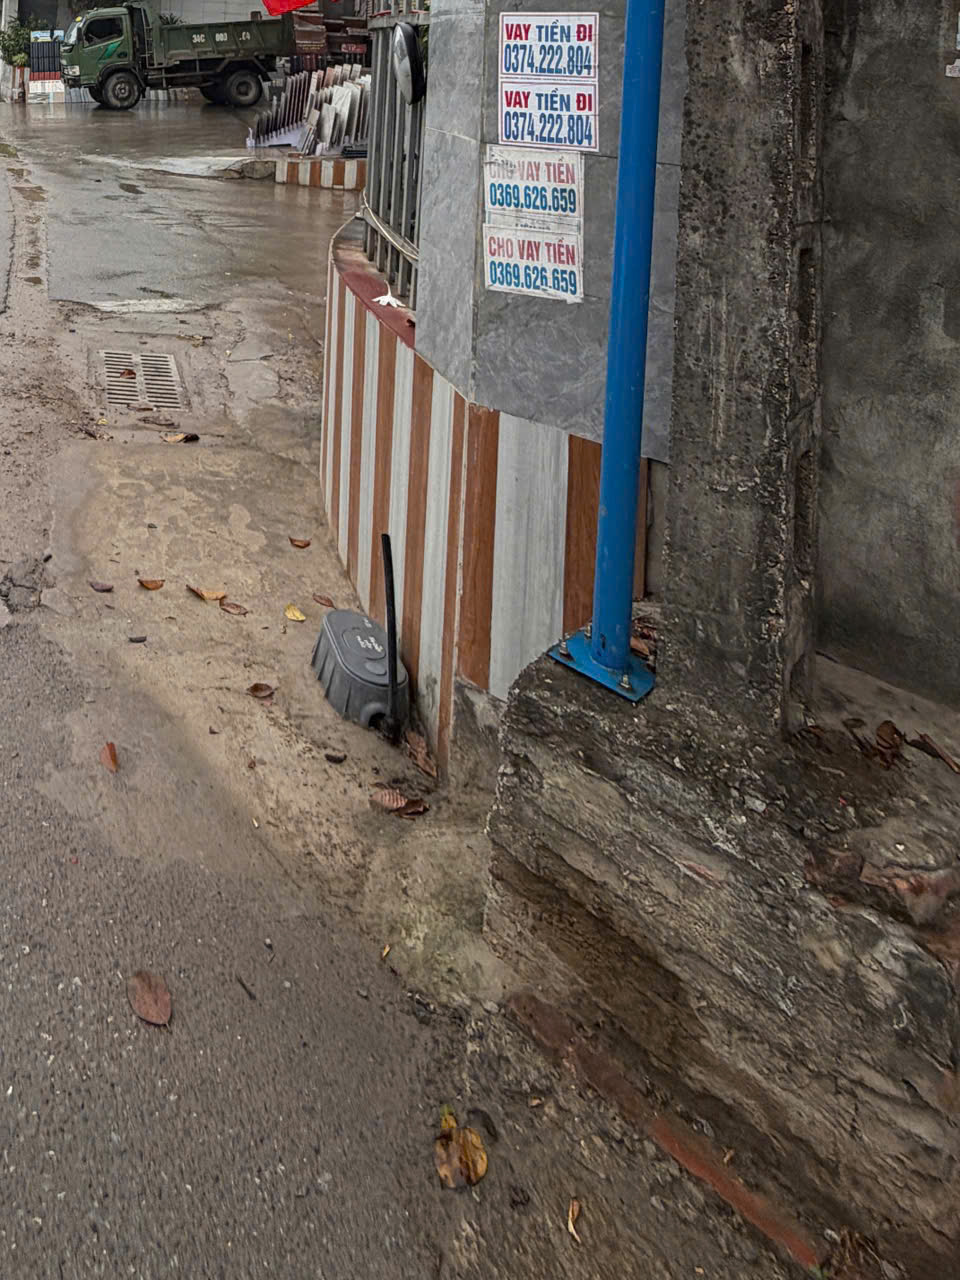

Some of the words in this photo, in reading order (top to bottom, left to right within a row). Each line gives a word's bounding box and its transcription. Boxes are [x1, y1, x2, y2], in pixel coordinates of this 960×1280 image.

[505, 23, 531, 41] VAY
[536, 19, 571, 42] TIỀN
[576, 24, 593, 42] ĐI
[504, 43, 592, 75] 0374.222.804
[504, 91, 531, 108] VAY
[535, 87, 571, 112] TIỀN
[576, 93, 593, 112] ĐI
[504, 111, 592, 145] 0374.222.804
[517, 160, 540, 182] VAY
[545, 156, 576, 185] TIỀN
[490, 183, 577, 213] 0369.626.659
[488, 236, 514, 258] CHO
[517, 239, 541, 262] VAY
[545, 237, 576, 265] TIỀN
[490, 261, 577, 296] 0369.626.659
